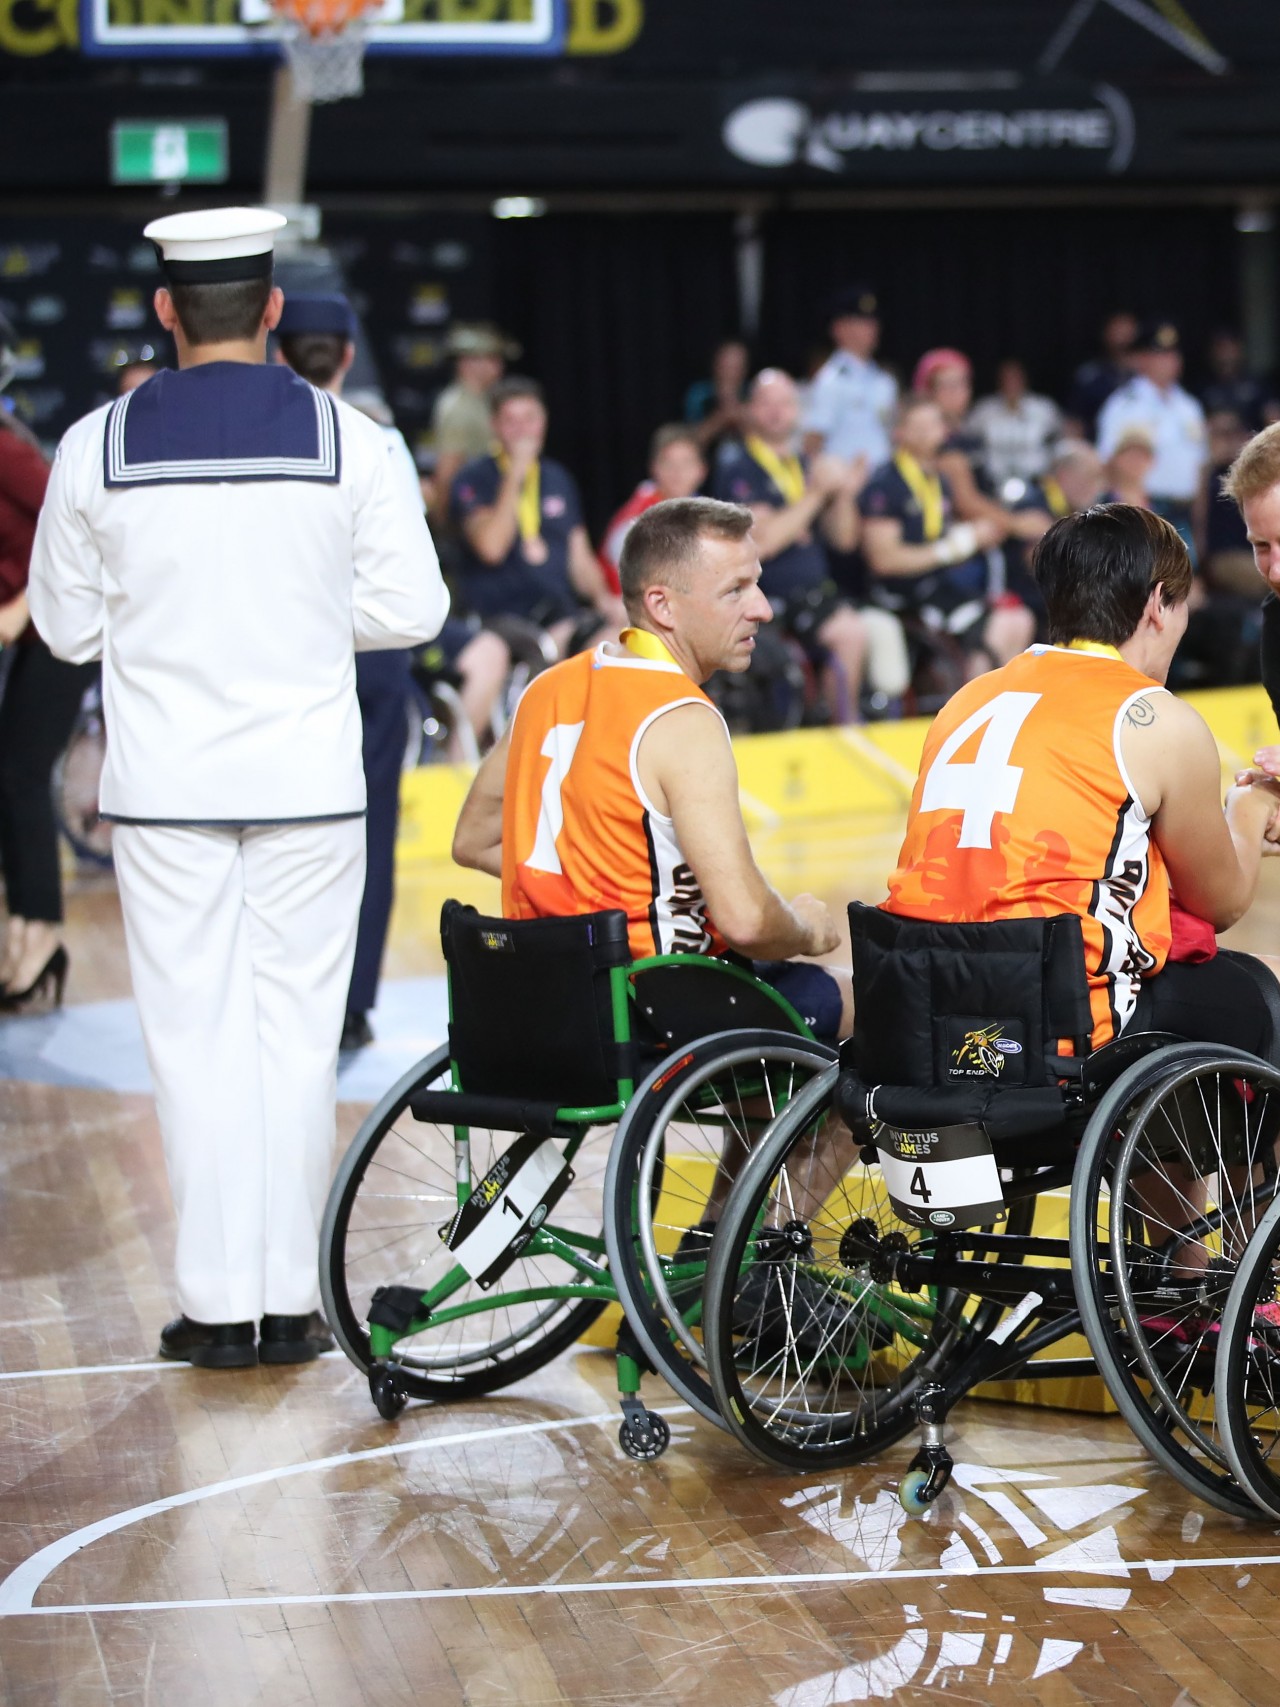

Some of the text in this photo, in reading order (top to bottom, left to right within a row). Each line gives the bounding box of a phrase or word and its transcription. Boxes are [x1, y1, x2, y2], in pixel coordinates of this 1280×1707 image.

[918, 691, 1043, 849] 4
[523, 720, 586, 876] 1
[948, 1068, 965, 1076] TOP
[889, 1130, 940, 1144] INVICTUS
[894, 1142, 932, 1155] GAMES
[470, 1154, 511, 1207] INVICTUS
[479, 1169, 509, 1208] GAMES
[909, 1166, 932, 1204] 4
[502, 1193, 525, 1221] 1
